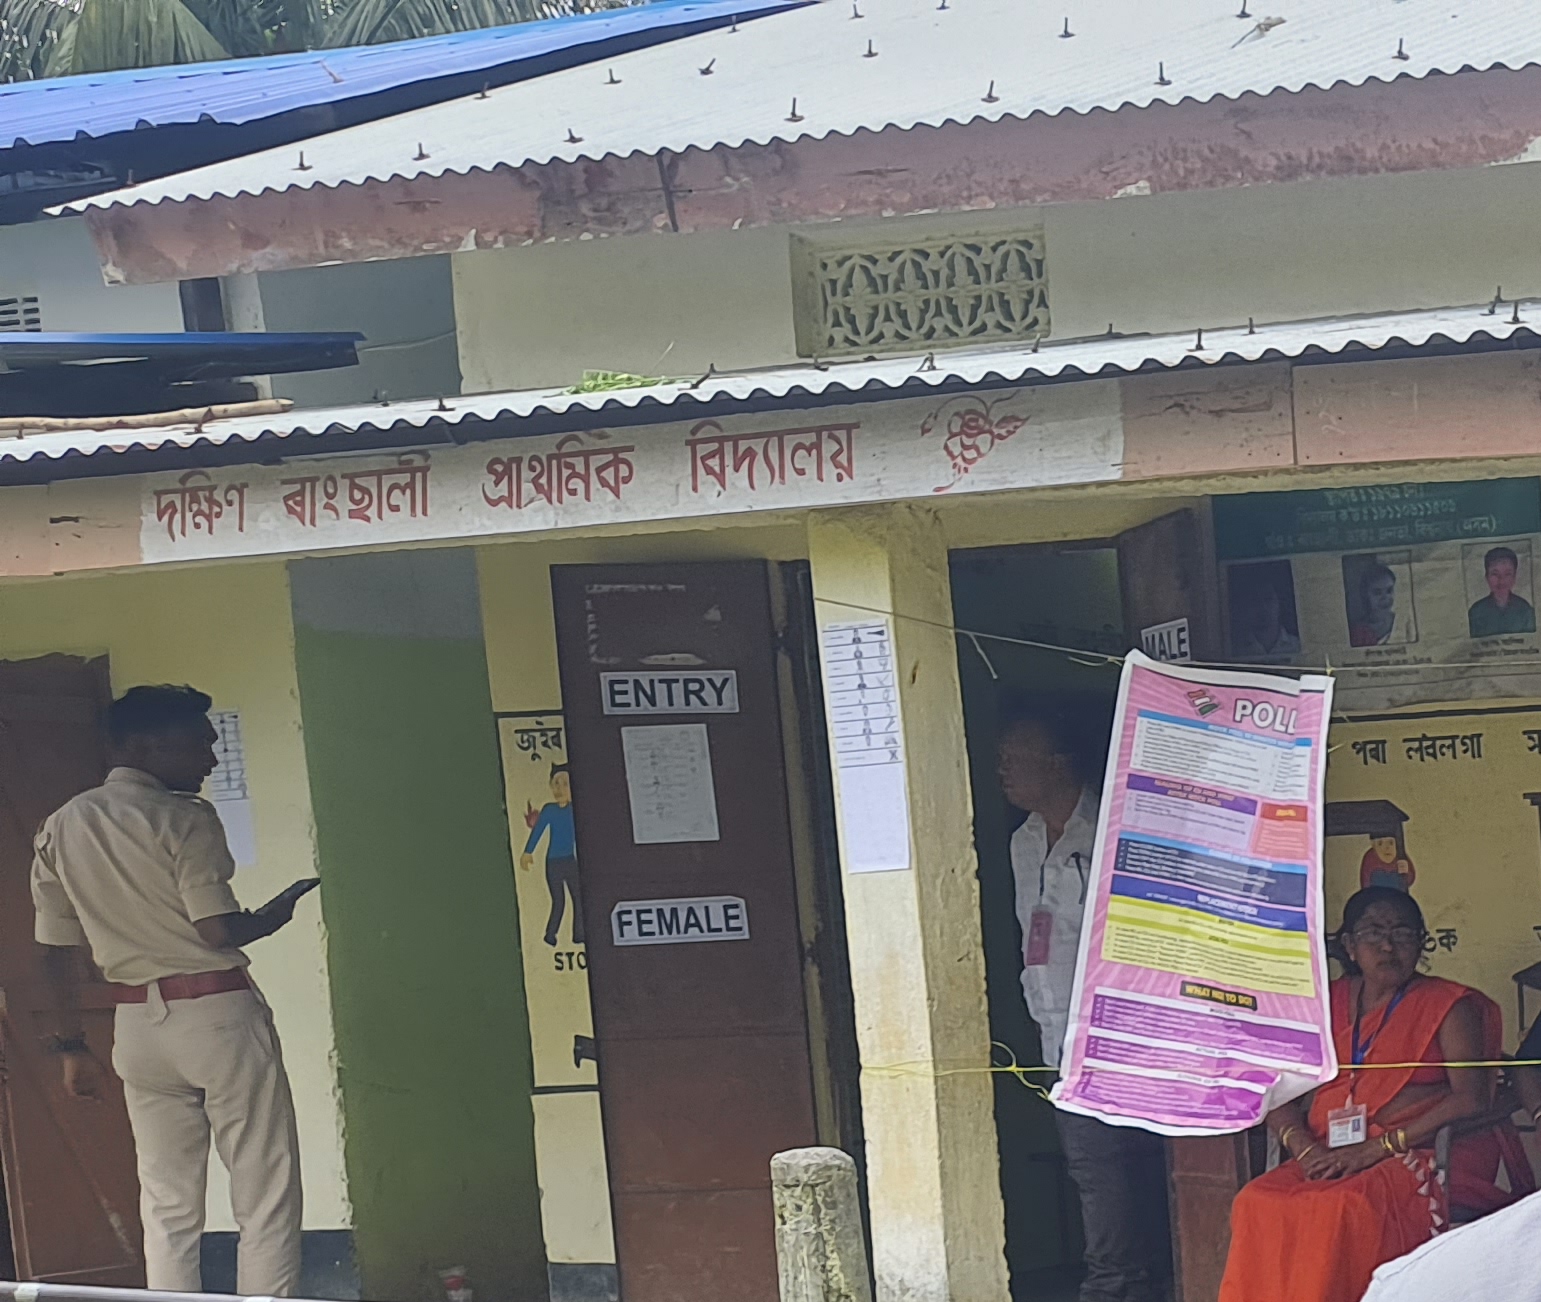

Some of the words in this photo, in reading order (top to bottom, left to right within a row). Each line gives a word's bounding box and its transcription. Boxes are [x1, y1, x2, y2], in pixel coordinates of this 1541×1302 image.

[153, 470, 249, 542] দক্ষিণ
[608, 677, 730, 709] ENTRY
[617, 903, 743, 939] FEMALE
[554, 951, 588, 970] STO
